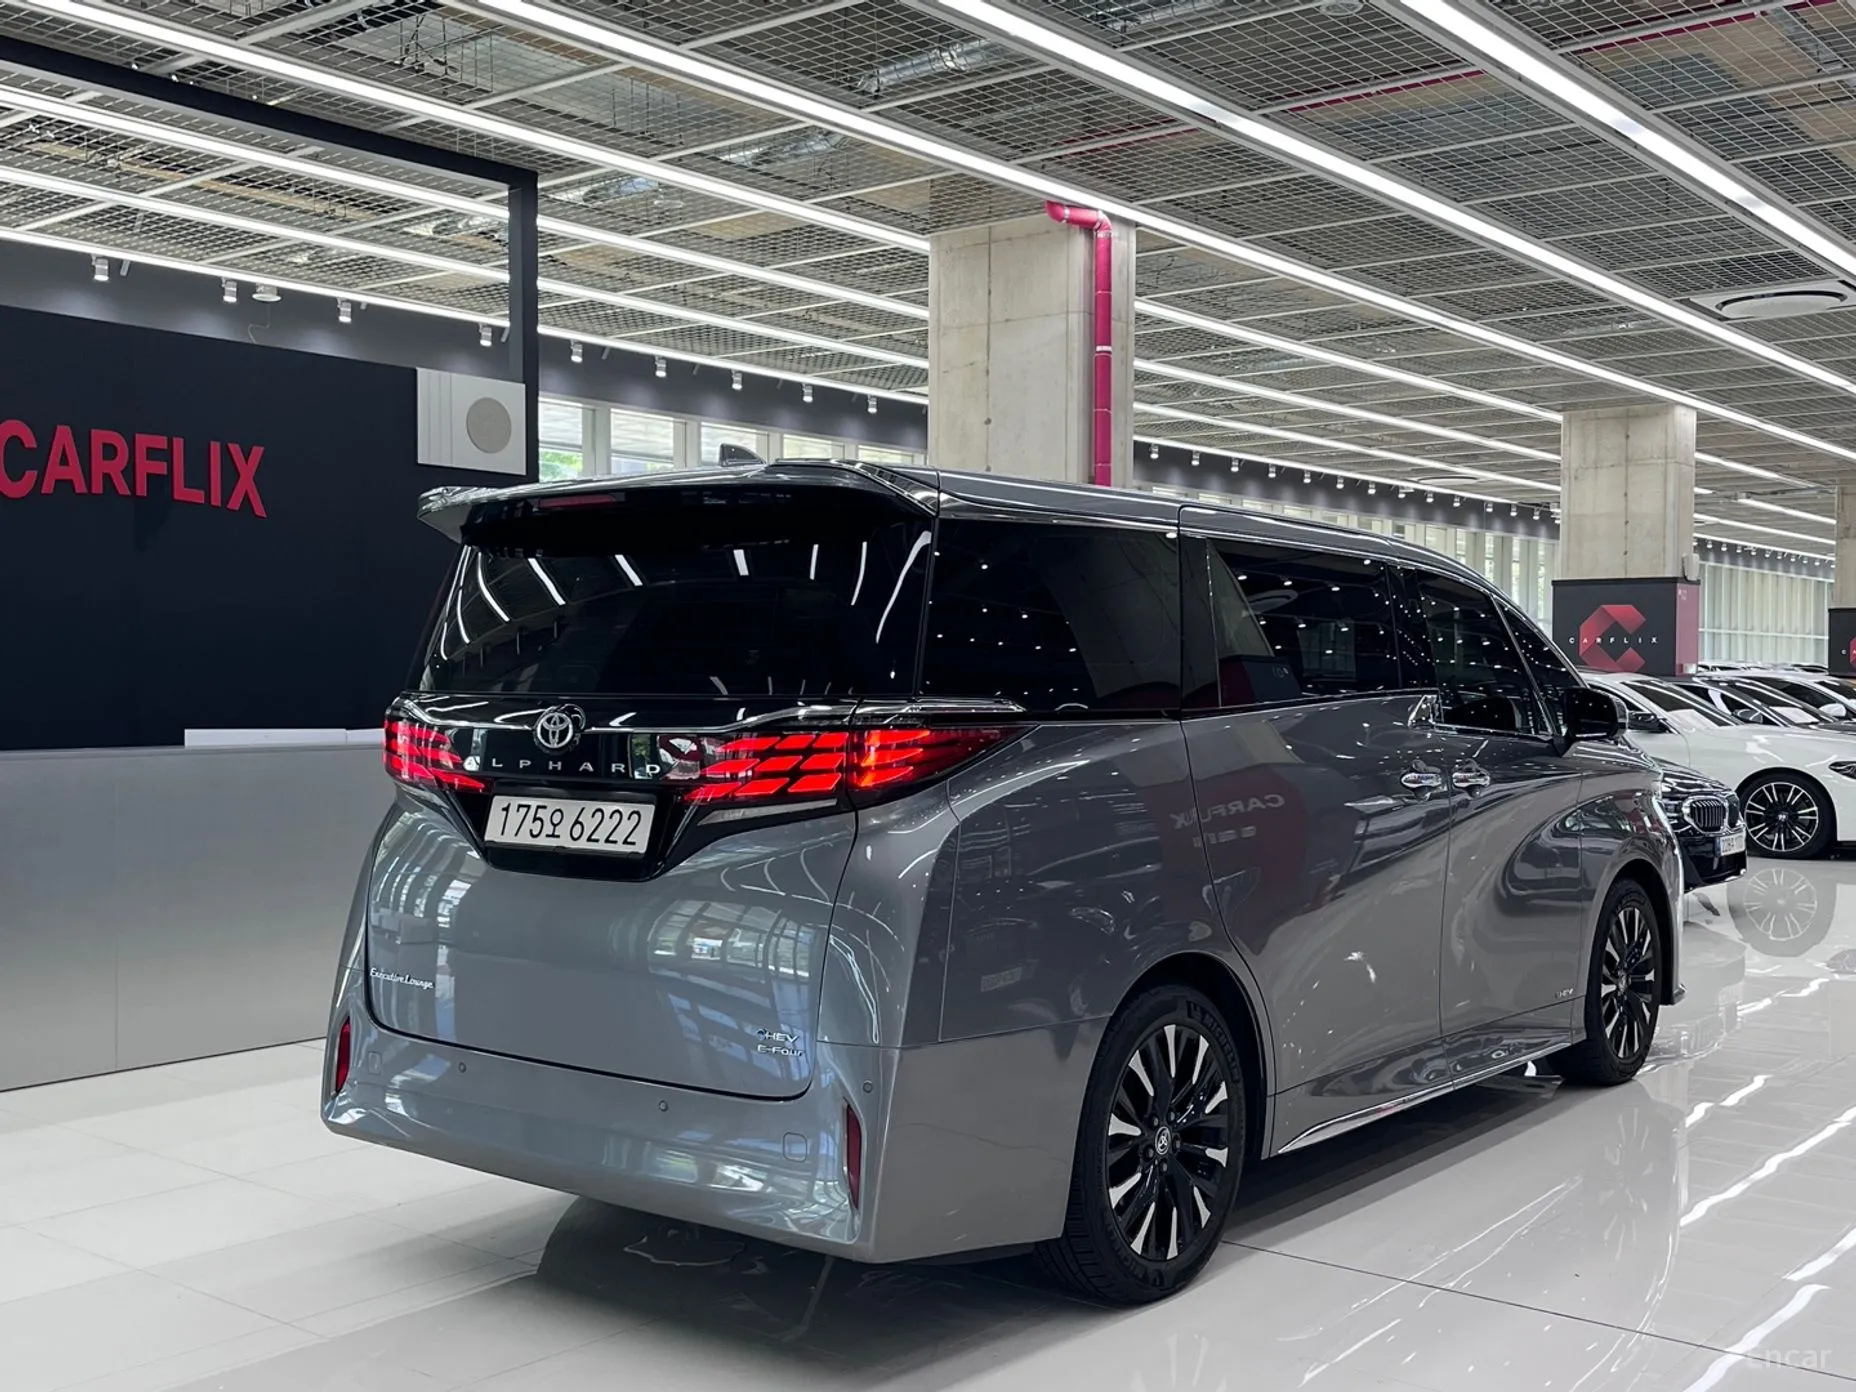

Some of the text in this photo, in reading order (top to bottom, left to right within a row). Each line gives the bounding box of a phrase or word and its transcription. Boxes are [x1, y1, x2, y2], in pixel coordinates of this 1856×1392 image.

[0, 419, 268, 518] CARFLIX
[1568, 636, 1658, 646] CARFLIX
[464, 755, 662, 775] LPHARD
[569, 806, 642, 846] 6222
